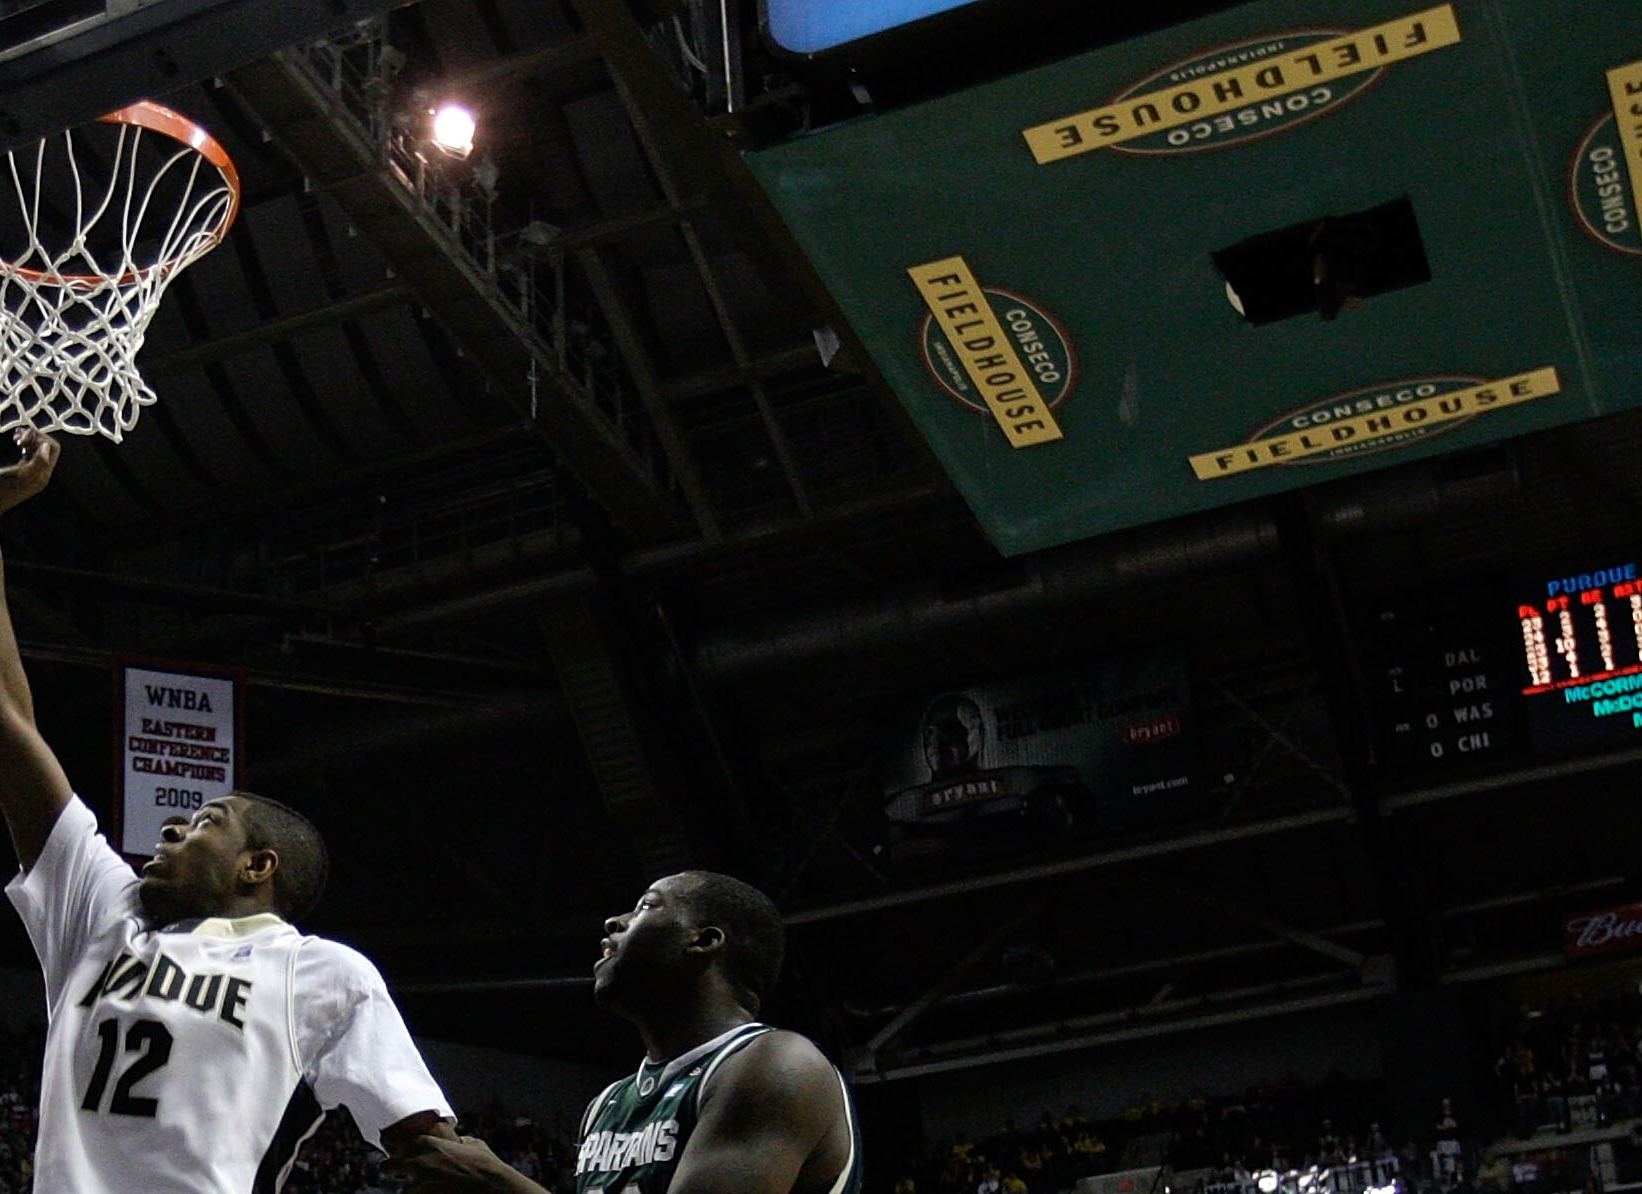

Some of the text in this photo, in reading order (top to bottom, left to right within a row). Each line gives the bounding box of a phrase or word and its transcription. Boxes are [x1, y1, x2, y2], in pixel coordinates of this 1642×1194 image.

[1053, 22, 1429, 149] FIELDHOUSE
[1166, 87, 1333, 146] CONSECO
[1589, 146, 1629, 233] CONSECO
[926, 273, 1046, 434] FIELDHOUSE
[1006, 308, 1060, 384] CONSECO
[1291, 383, 1437, 429] CONSECO
[1214, 379, 1535, 471] FIELDHOUSE
[1546, 563, 1639, 598] PURDUE
[144, 684, 214, 713] WNBA
[1449, 674, 1488, 697] POR
[142, 717, 217, 743] EASTERN
[1453, 702, 1495, 724] WAS
[129, 735, 231, 764] CONFERENCE
[1457, 731, 1492, 753] CHI
[132, 755, 226, 783] CHAMPIONS
[155, 786, 204, 811] 2009
[81, 1017, 174, 1118] 12
